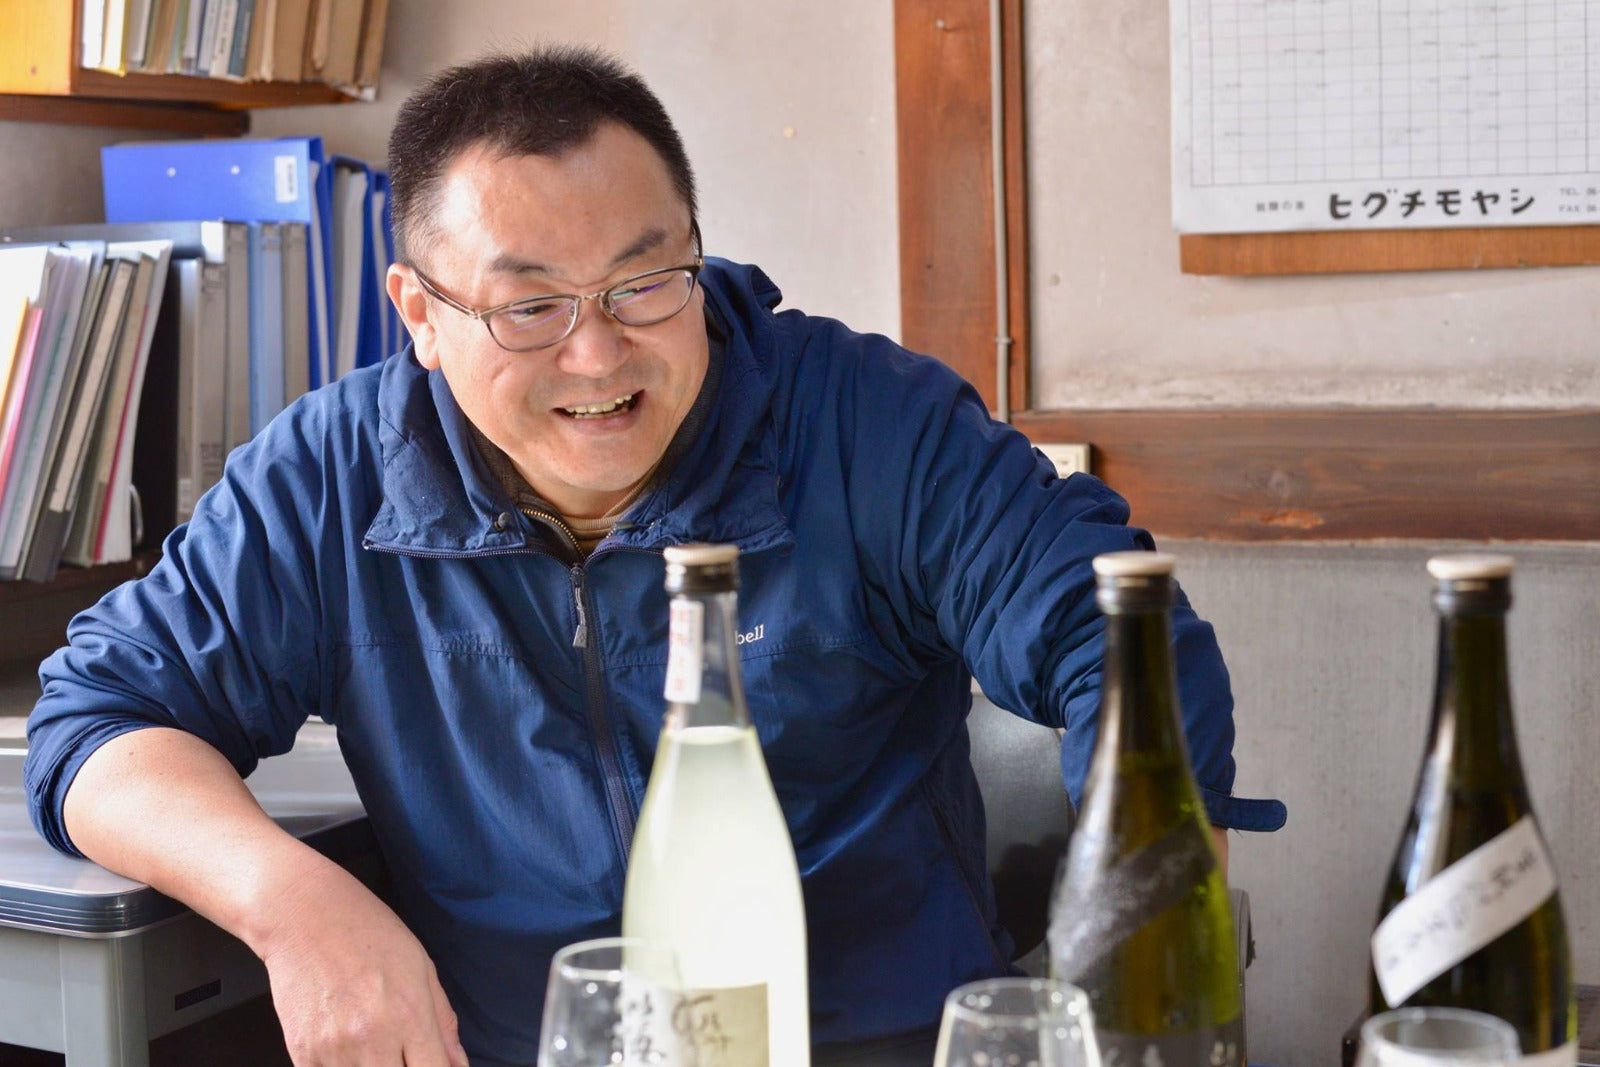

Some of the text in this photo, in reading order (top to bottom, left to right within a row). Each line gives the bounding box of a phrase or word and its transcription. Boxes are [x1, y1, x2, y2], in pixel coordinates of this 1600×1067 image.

[1329, 188, 1535, 219] ヒグチモヤシ
